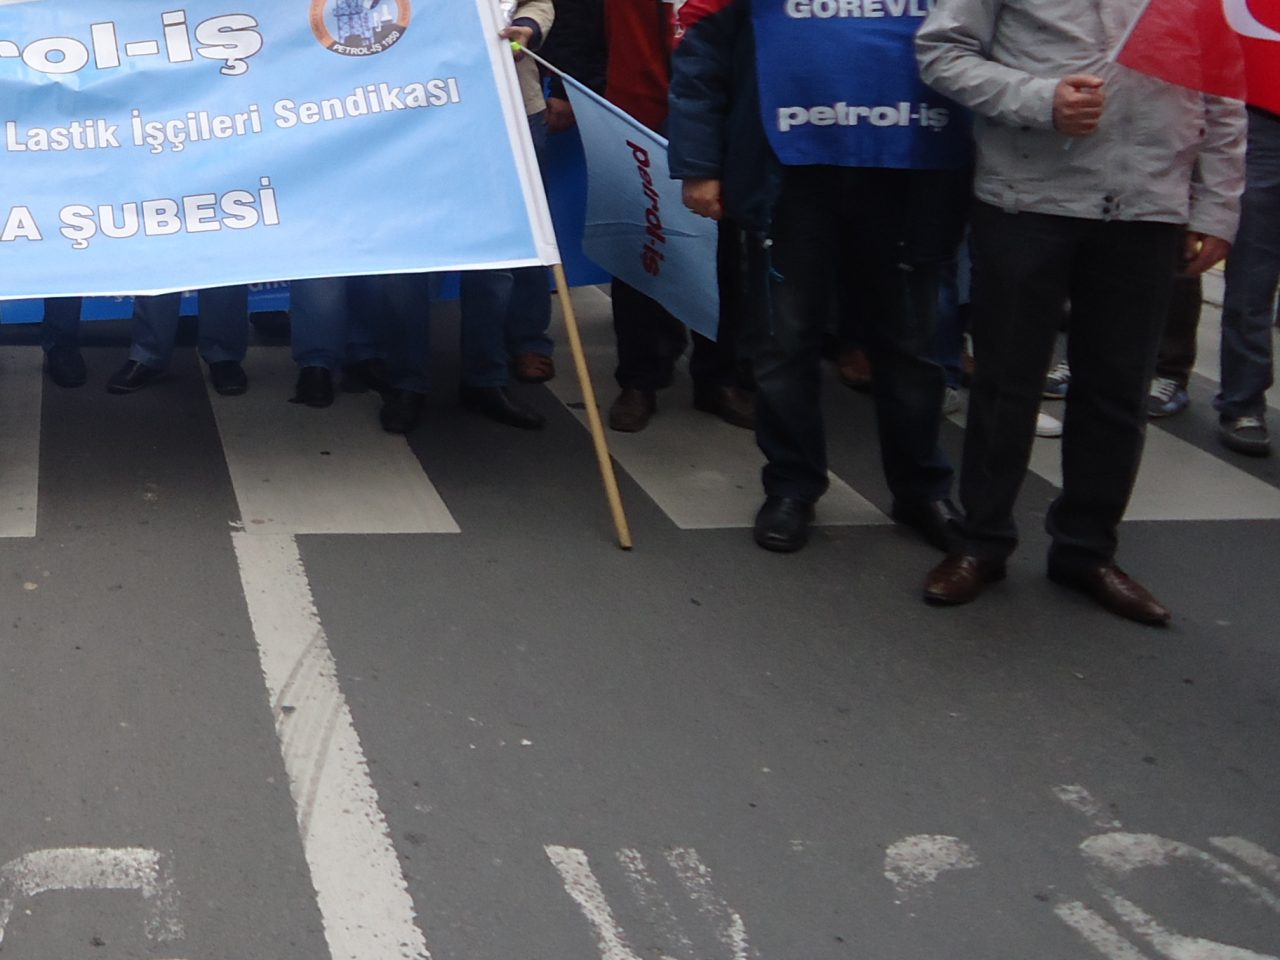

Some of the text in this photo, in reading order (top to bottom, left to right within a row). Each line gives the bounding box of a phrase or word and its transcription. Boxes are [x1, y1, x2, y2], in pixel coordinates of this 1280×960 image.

[5, 117, 121, 154] Lastik
[131, 102, 263, 155] İşçileri
[274, 76, 463, 130] Sendikası
[777, 101, 950, 133] petrol-iş
[58, 176, 281, 251] ŞUBESİ
